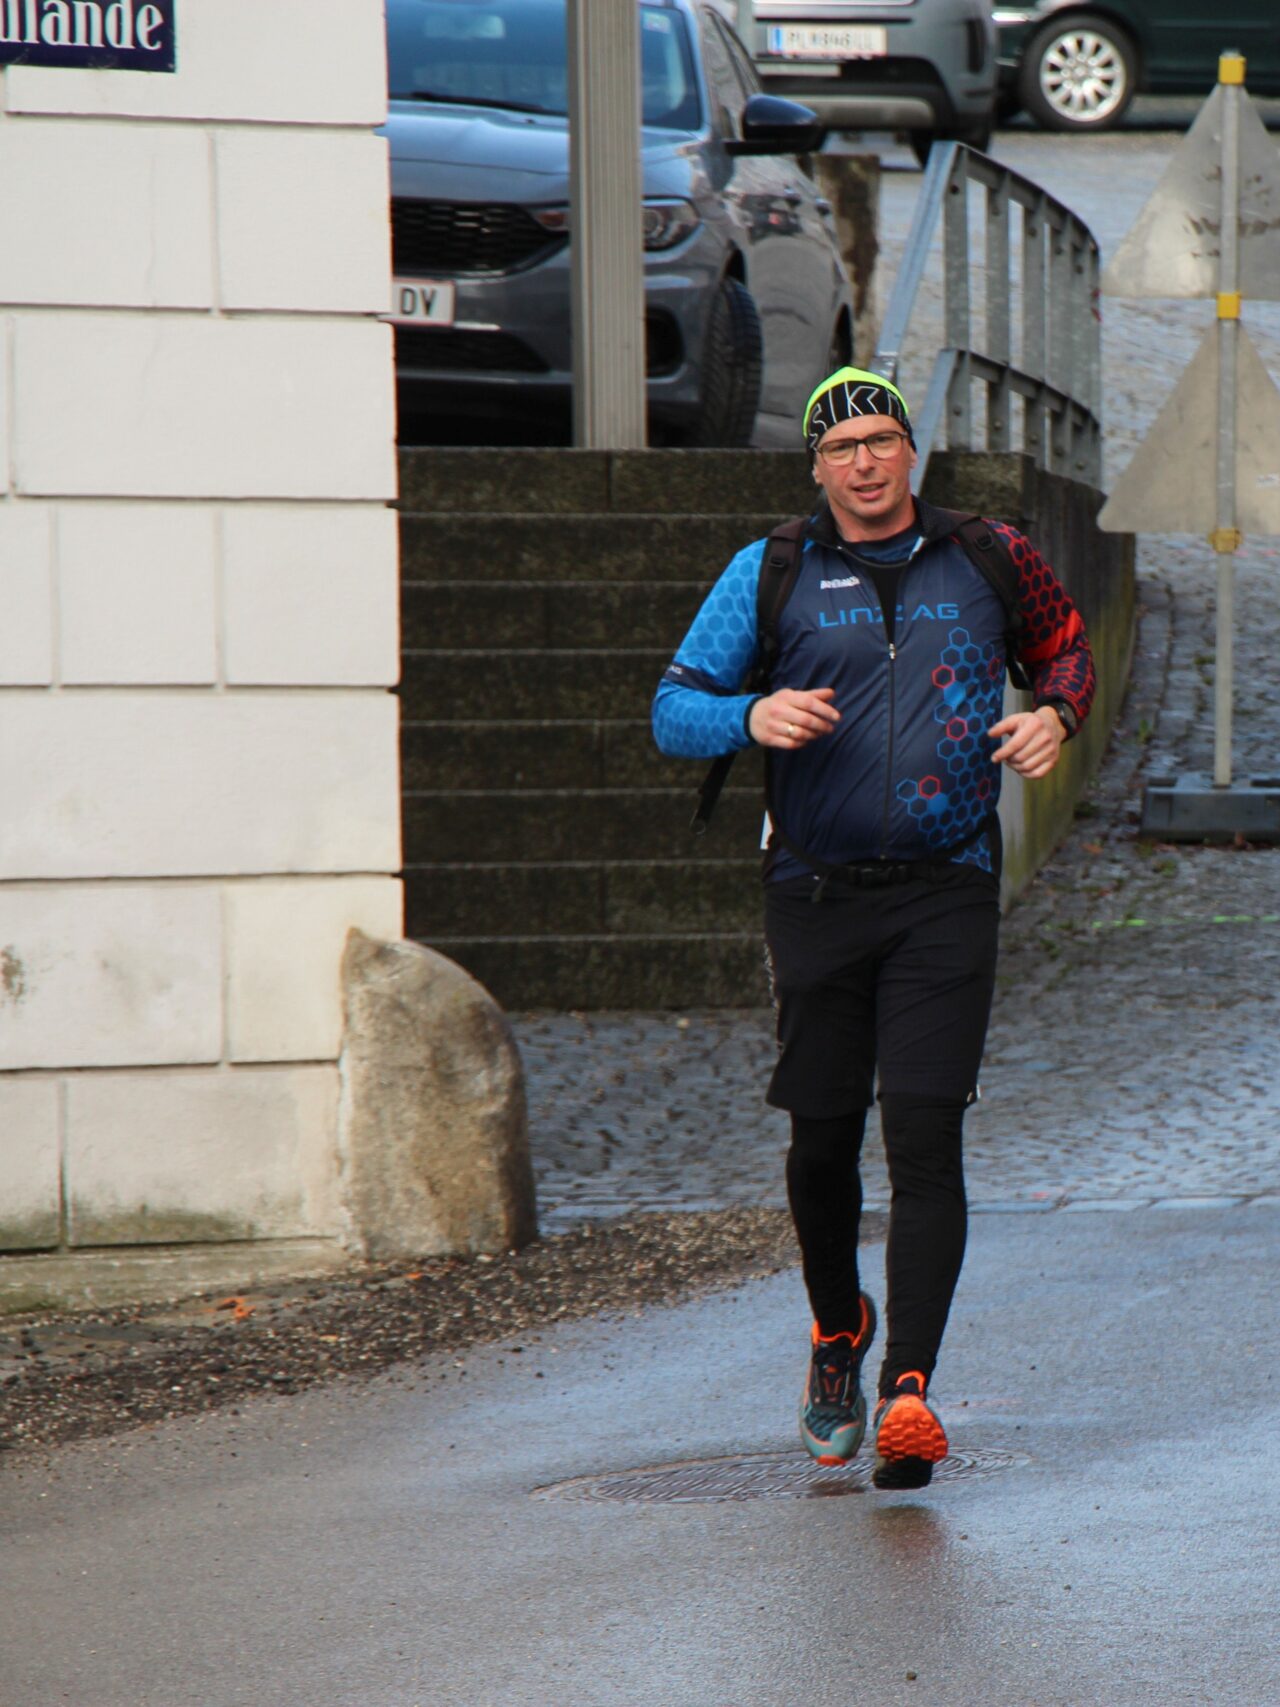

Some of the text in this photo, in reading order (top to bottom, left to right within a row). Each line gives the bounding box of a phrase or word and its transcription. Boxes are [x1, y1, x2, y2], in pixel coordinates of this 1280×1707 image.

[400, 287, 437, 317] DV
[818, 603, 960, 628] LINZ AG
